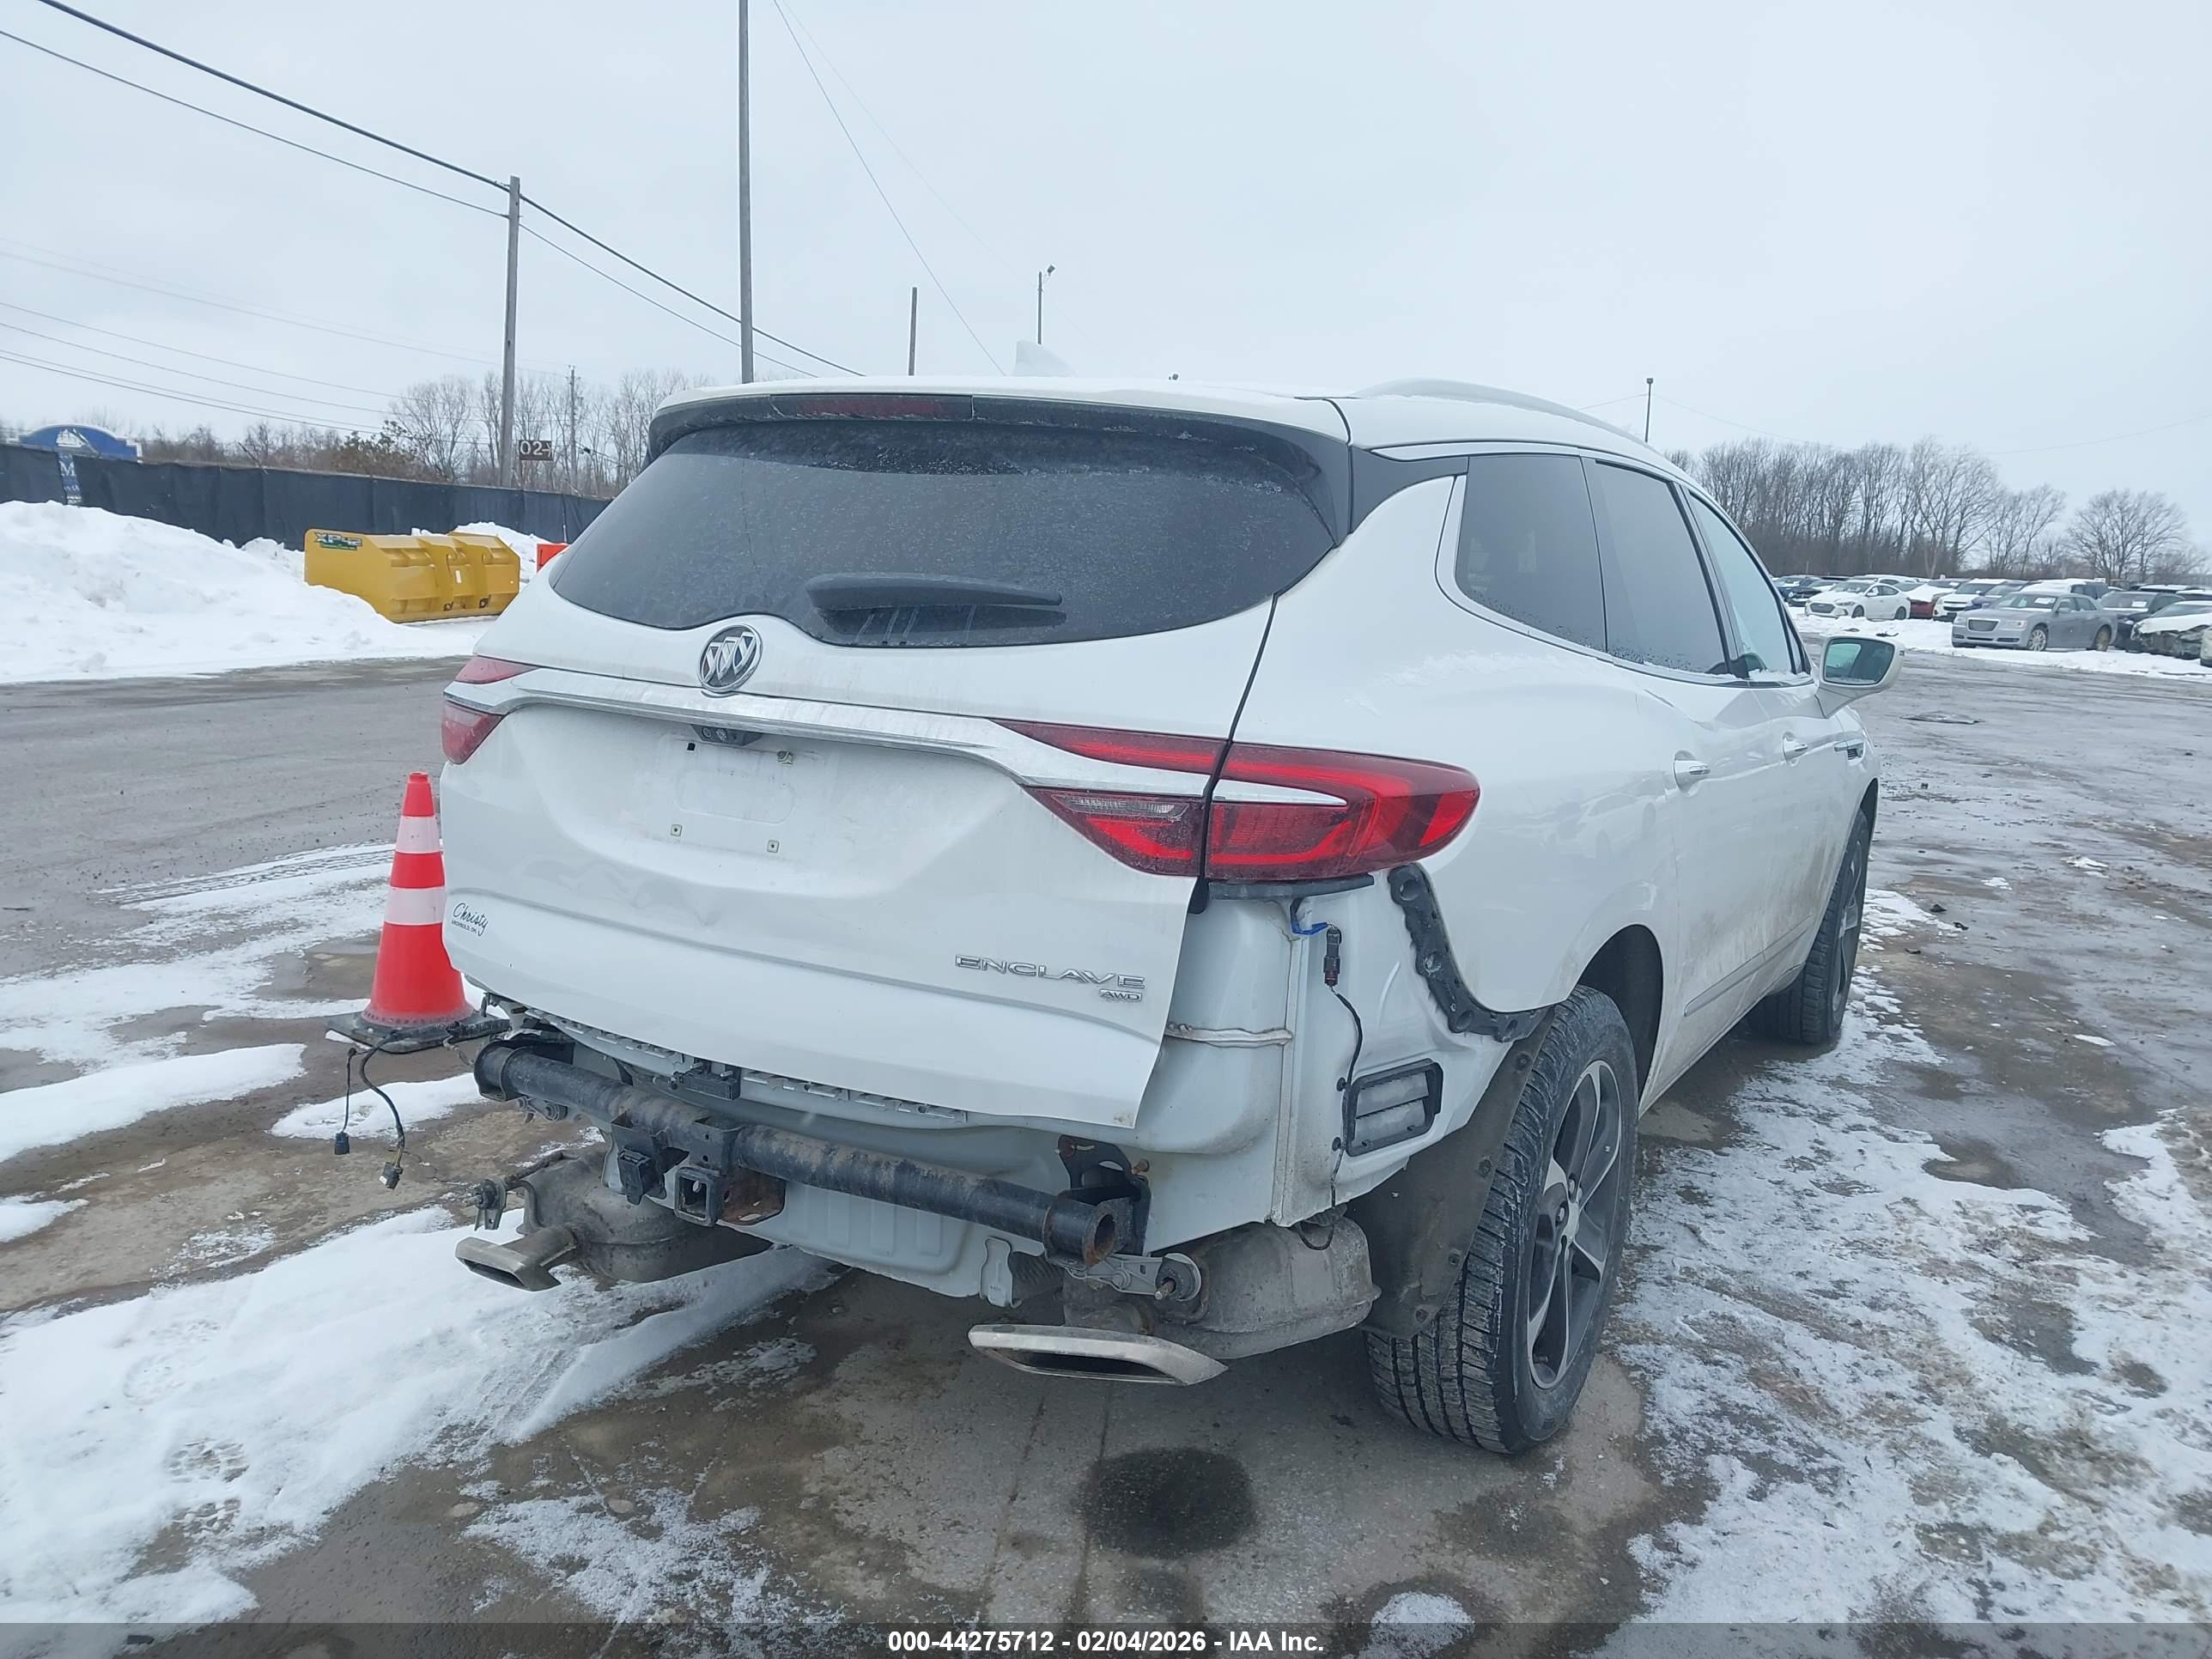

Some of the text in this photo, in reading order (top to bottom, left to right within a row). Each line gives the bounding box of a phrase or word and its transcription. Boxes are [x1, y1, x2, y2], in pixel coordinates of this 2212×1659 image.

[453, 902, 489, 937] Christy
[955, 954, 1146, 989] ENCLAVE
[1101, 990, 1143, 1001] AWD
